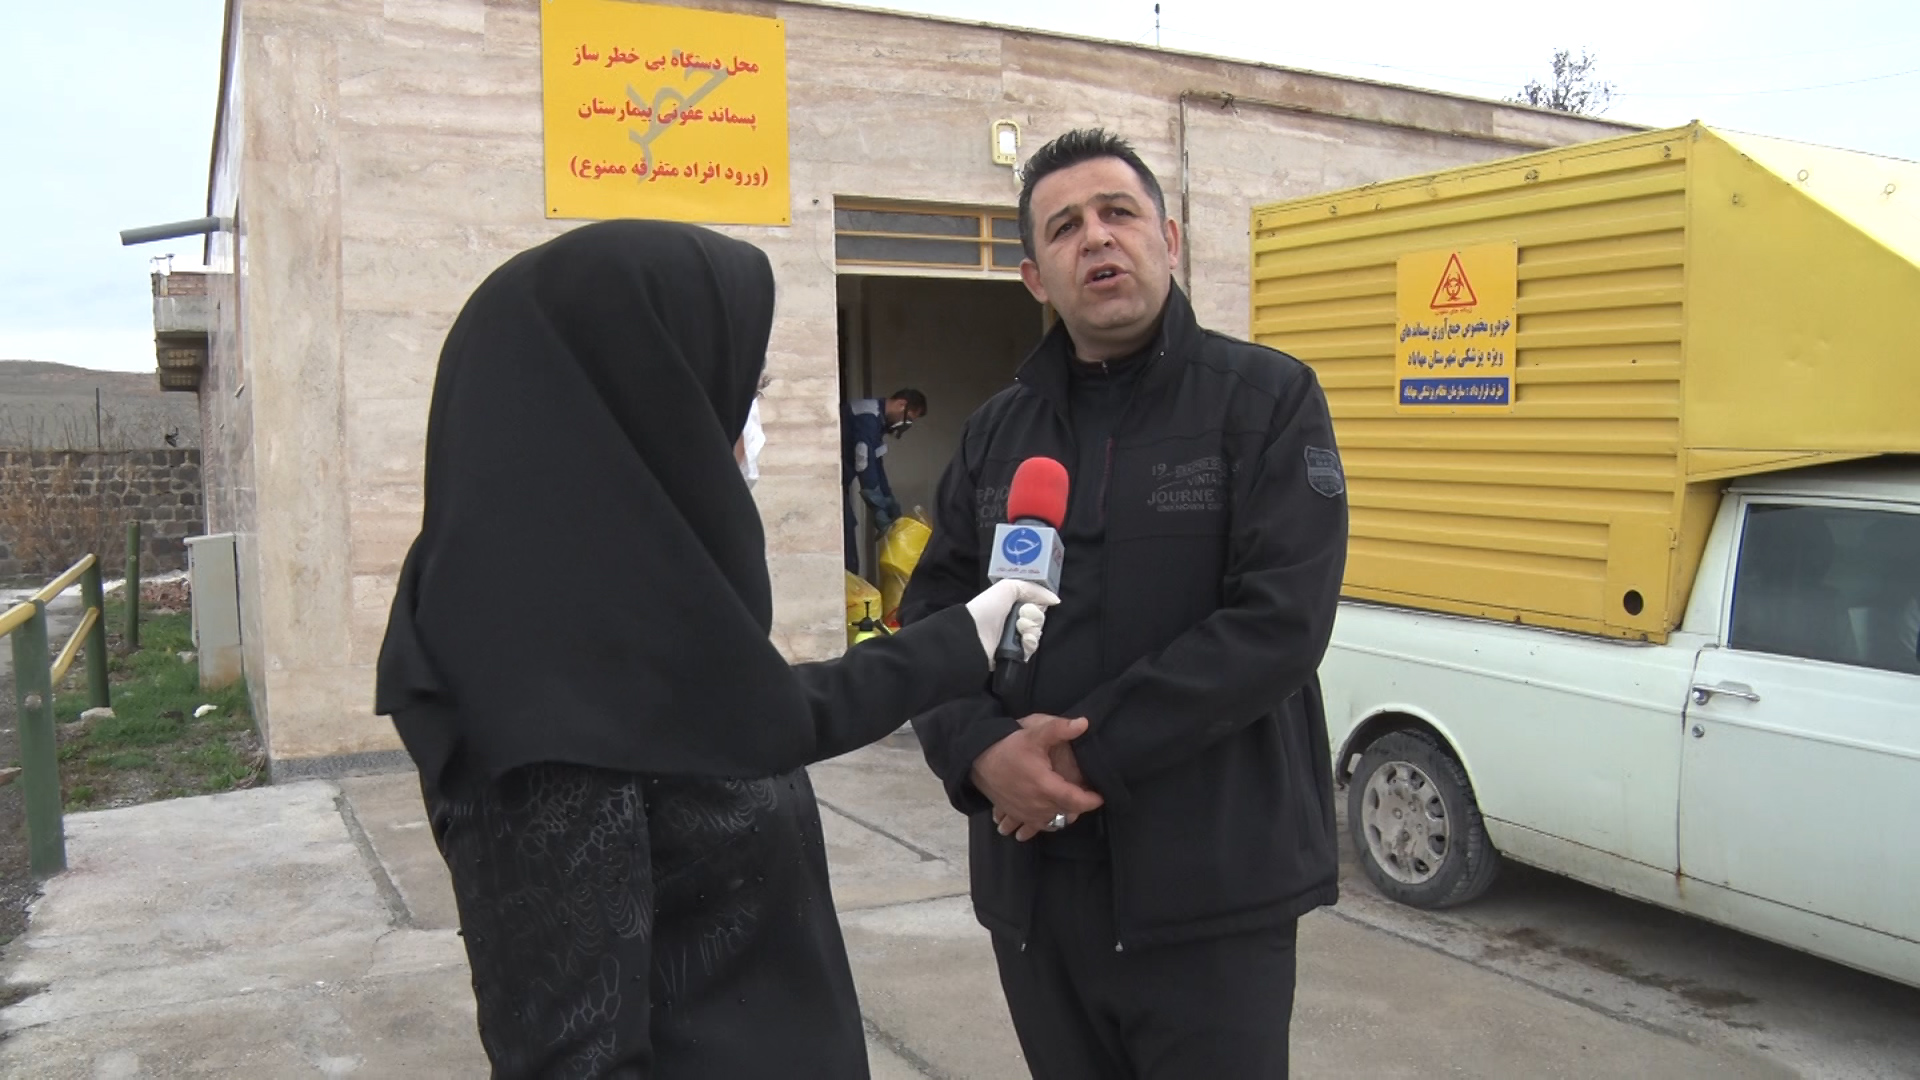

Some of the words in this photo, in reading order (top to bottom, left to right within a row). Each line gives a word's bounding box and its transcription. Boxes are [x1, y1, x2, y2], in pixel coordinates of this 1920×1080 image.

[572, 44, 600, 66] ساز
[605, 47, 640, 68] خطر
[644, 54, 666, 72] بی
[670, 50, 722, 71] دستگاه
[726, 56, 760, 76] محل
[578, 97, 653, 122] بیمارستان
[656, 103, 704, 126] عفونی
[708, 106, 757, 131] پسماند
[570, 155, 627, 180] ممنوع)
[631, 156, 679, 182] متفرقه
[683, 160, 721, 184] افراد
[724, 165, 769, 188] (ورود
[1462, 317, 1488, 338] مخصوص
[1488, 315, 1510, 338] خودرو
[1407, 350, 1427, 370] مهاباد
[1427, 347, 1456, 370] شهرستان
[1457, 347, 1485, 369] پزشکی
[1486, 347, 1504, 368] ویژه
[1187, 473, 1218, 486] VINTA
[1147, 489, 1216, 506] JOURNE
